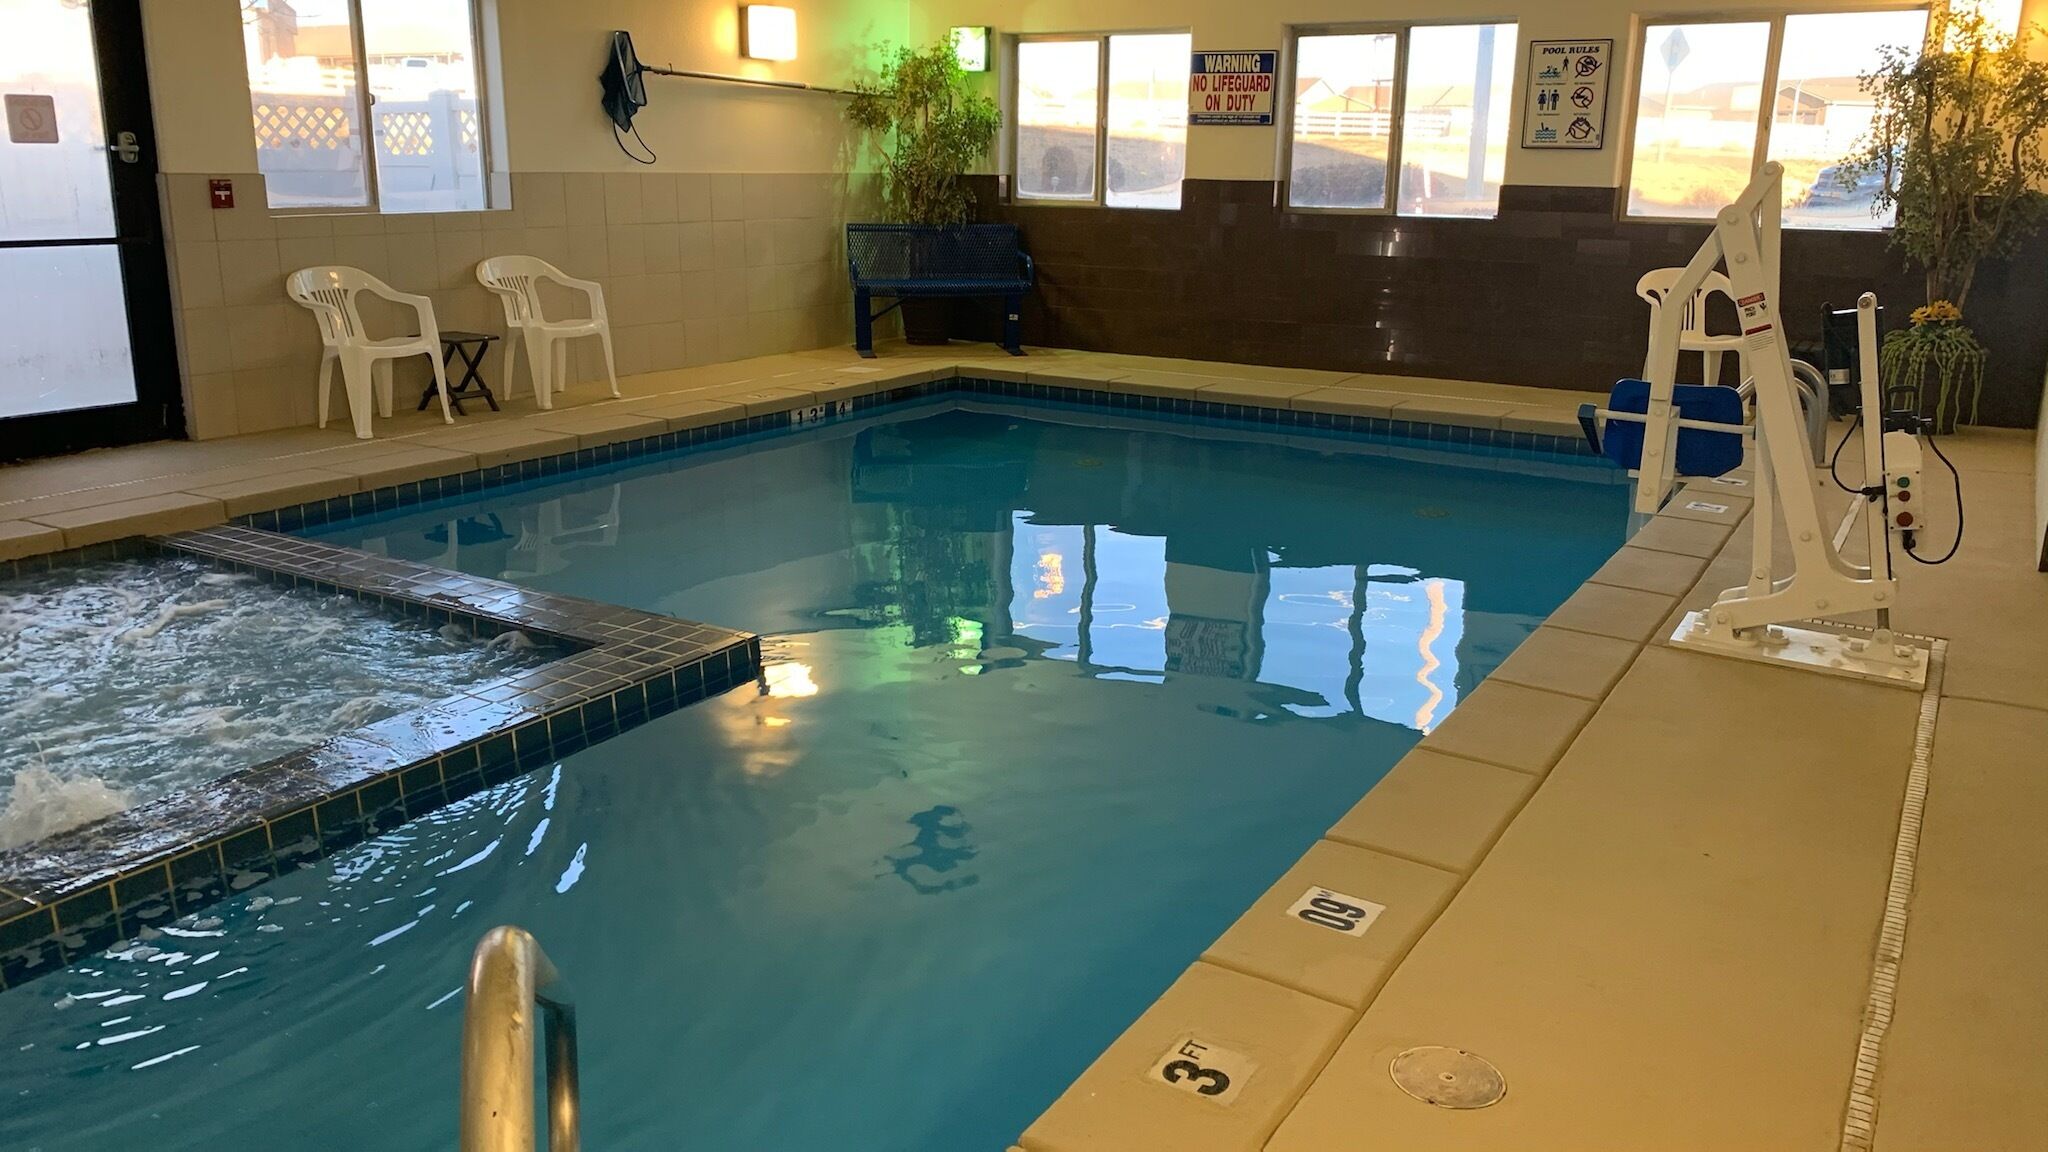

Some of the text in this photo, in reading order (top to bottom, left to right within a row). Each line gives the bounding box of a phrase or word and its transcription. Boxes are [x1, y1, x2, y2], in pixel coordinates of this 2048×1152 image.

[1568, 46, 1600, 54] RULES
[1204, 54, 1261, 73] WARNING
[1192, 74, 1271, 92] NO LIFEGUARD
[1205, 94, 1256, 111] ON DUTY
[1162, 1039, 1230, 1096] 3 FT
